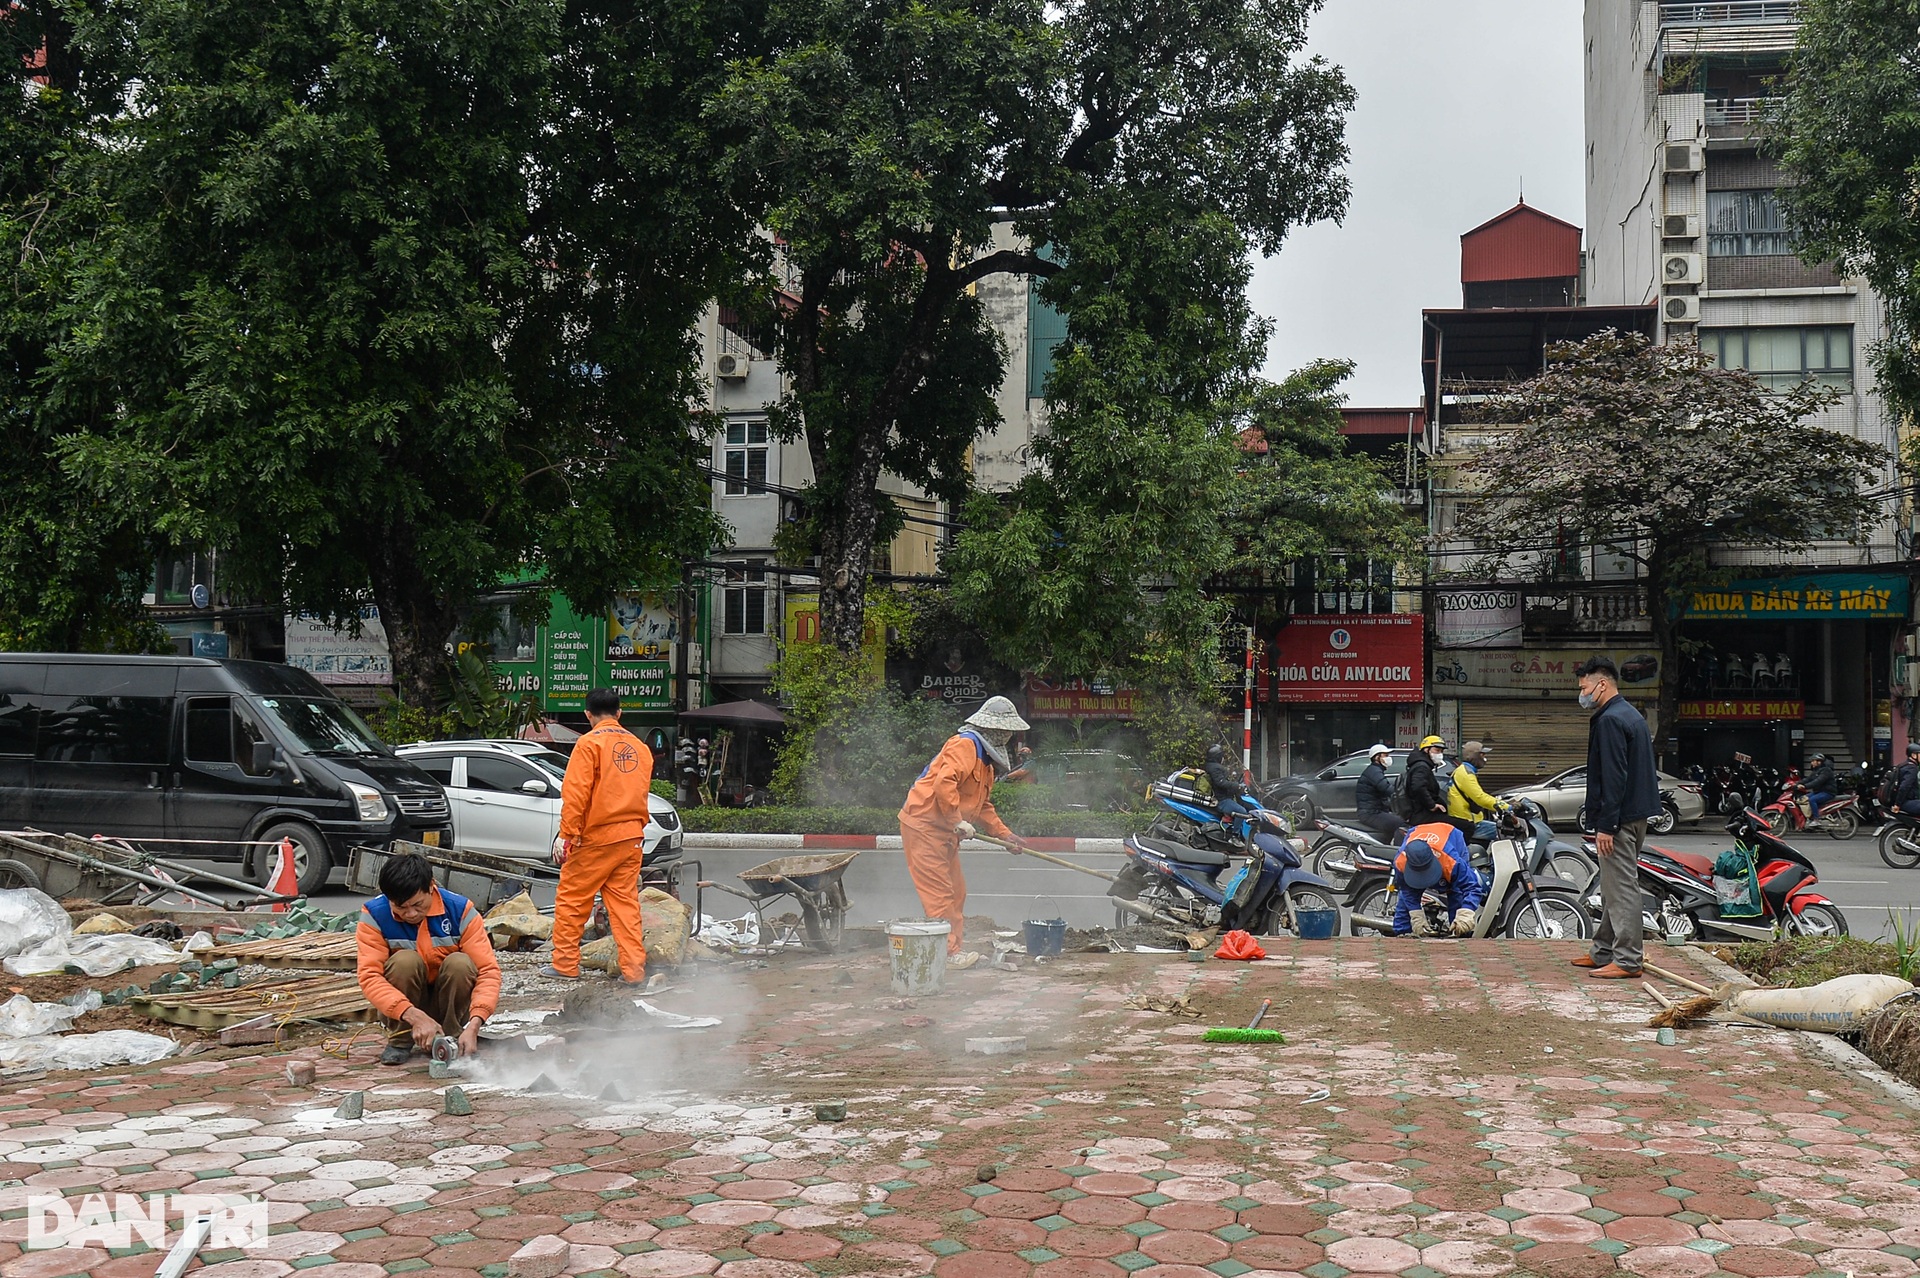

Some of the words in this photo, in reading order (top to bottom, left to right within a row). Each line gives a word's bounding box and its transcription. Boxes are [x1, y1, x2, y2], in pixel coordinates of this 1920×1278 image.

[1440, 594, 1469, 610] BAO
[1469, 593, 1498, 610] CAO
[1498, 592, 1517, 608] SU
[1693, 592, 1745, 611] MUA
[1751, 586, 1799, 611] BÁN
[1805, 590, 1833, 610] XE
[1839, 585, 1892, 610] MÁY
[608, 645, 634, 656] KOKO
[637, 645, 658, 656] VET
[611, 665, 639, 679] PHÒNG
[640, 665, 664, 679] KHÁM
[1277, 662, 1308, 681] HÓA
[1312, 661, 1341, 681] CỬA
[1344, 666, 1412, 682] ANYLOCK
[518, 671, 541, 691] MÈO
[920, 674, 986, 689] BARBER
[612, 682, 630, 696] THÚ
[632, 685, 638, 696] Y
[639, 685, 662, 696] 24/7
[1034, 696, 1052, 710] MUA
[1054, 695, 1071, 710] BÁN
[1079, 697, 1099, 710] TRAO
[1679, 702, 1701, 715] UA
[1705, 701, 1737, 715] BÁN
[1742, 703, 1761, 715] XE
[1766, 701, 1800, 715] MÁY
